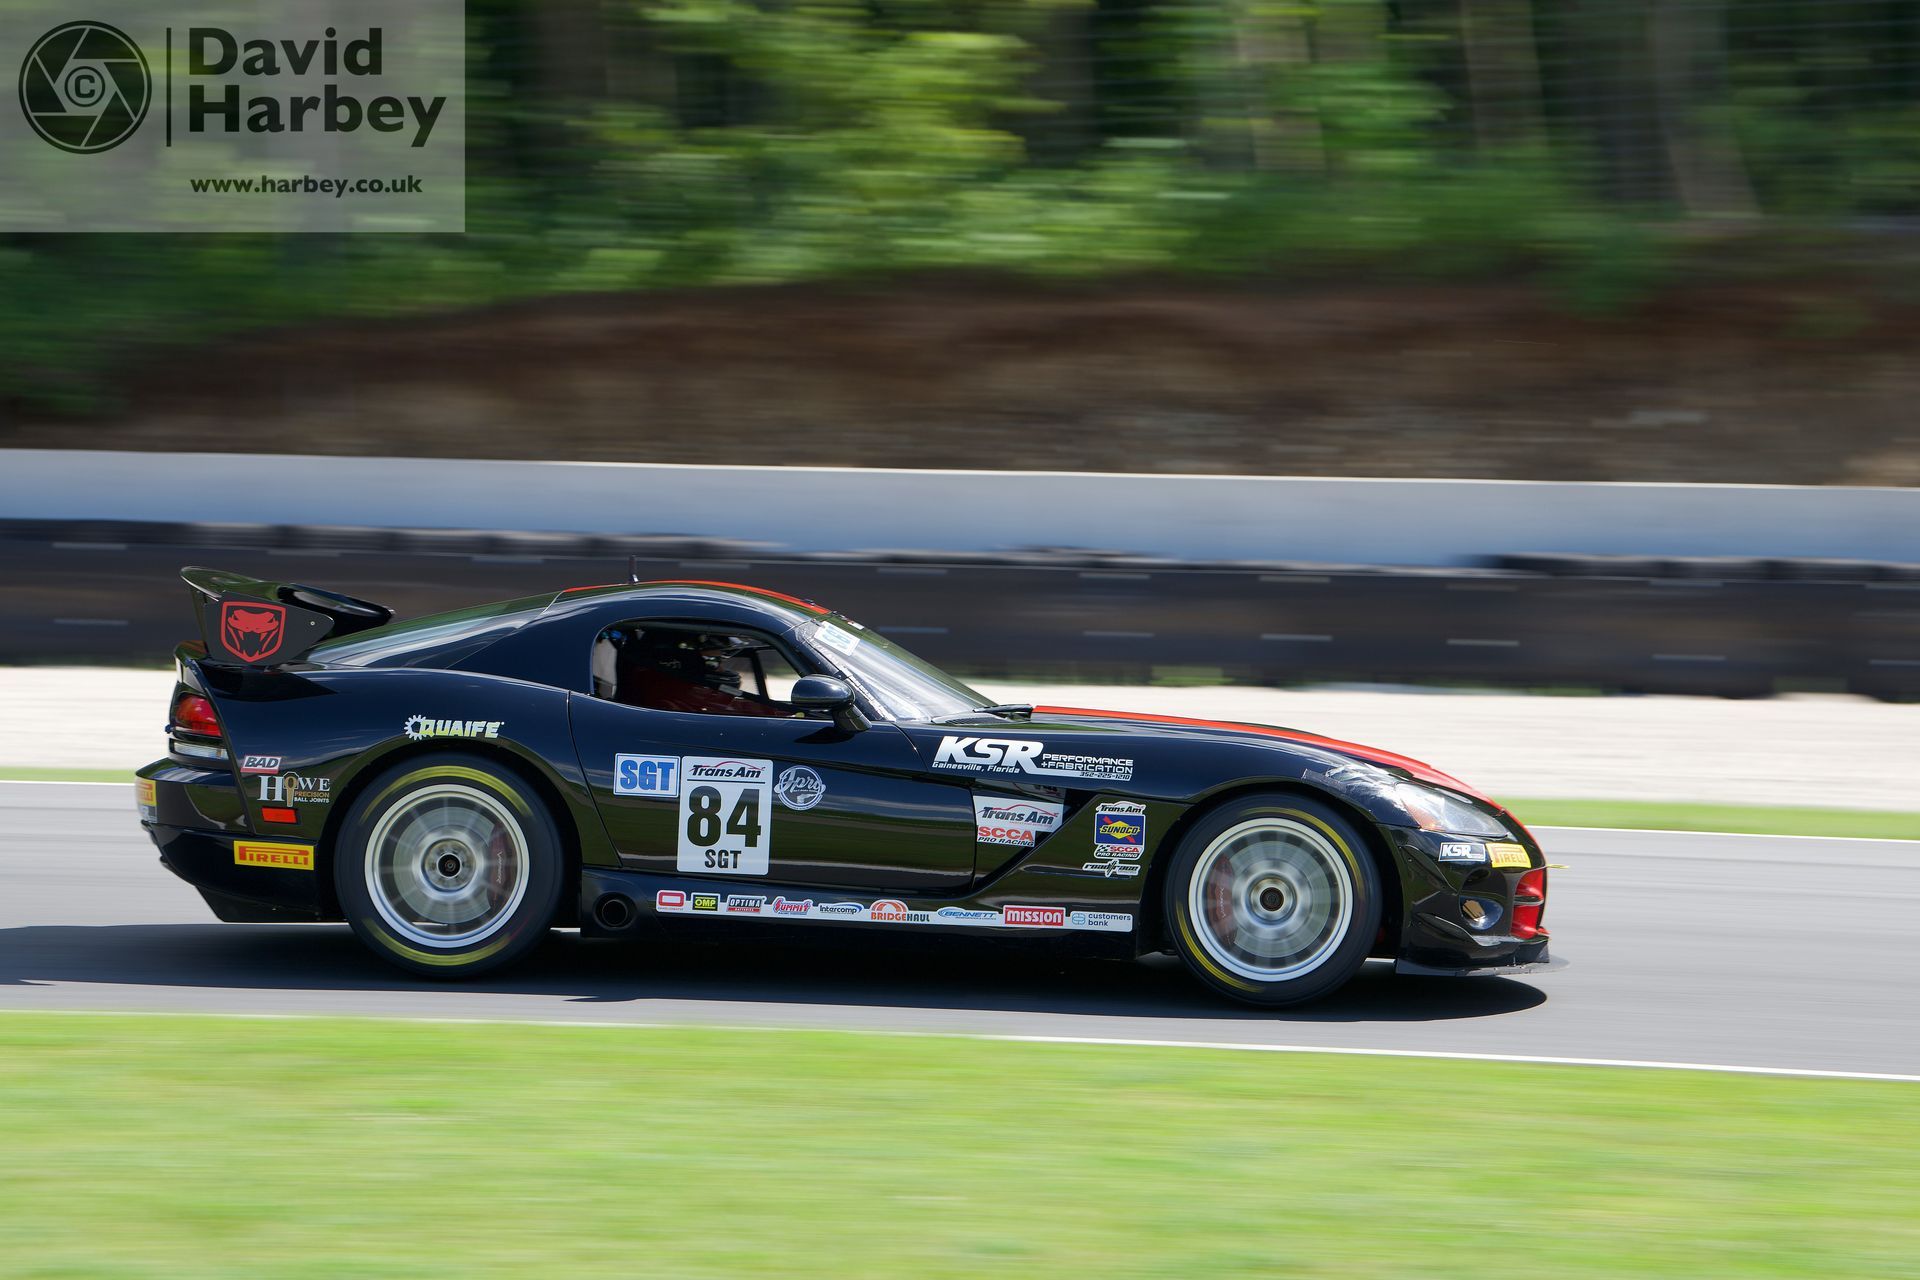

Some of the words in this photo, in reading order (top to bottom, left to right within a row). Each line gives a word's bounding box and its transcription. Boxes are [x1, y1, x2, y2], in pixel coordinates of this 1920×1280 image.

[404, 715, 501, 740] QUAIFE
[934, 736, 1044, 772] KSR
[1042, 753, 1134, 767] PERFORMANCE
[245, 756, 279, 768] BAD
[932, 761, 985, 772] Gainesville,
[987, 765, 1020, 774] Florida
[620, 759, 675, 791] SGT
[691, 764, 733, 778] Trans
[732, 766, 762, 779] Am
[294, 790, 330, 798] PRECISION
[1100, 804, 1125, 813] Trans
[1124, 806, 1142, 814] Am
[686, 785, 762, 848] 84
[981, 806, 1025, 821] Trans
[1025, 811, 1054, 825] Am
[978, 826, 1034, 841] SCCA
[1101, 826, 1139, 835] SUNOCO
[999, 837, 1034, 847] RACING
[1109, 845, 1139, 853] SCCA
[1442, 844, 1472, 858] KSR
[239, 845, 309, 867] PIRELLI
[704, 849, 742, 869] SGT
[694, 898, 716, 907] OMP
[729, 897, 761, 908] OPTIMA
[819, 904, 858, 915] Intercomp
[944, 910, 997, 918] BENNETT
[871, 912, 930, 922] BRIDGEHAUL
[1006, 909, 1062, 923] MISSION
[1088, 912, 1131, 921] customers
[1088, 918, 1109, 927] bank
